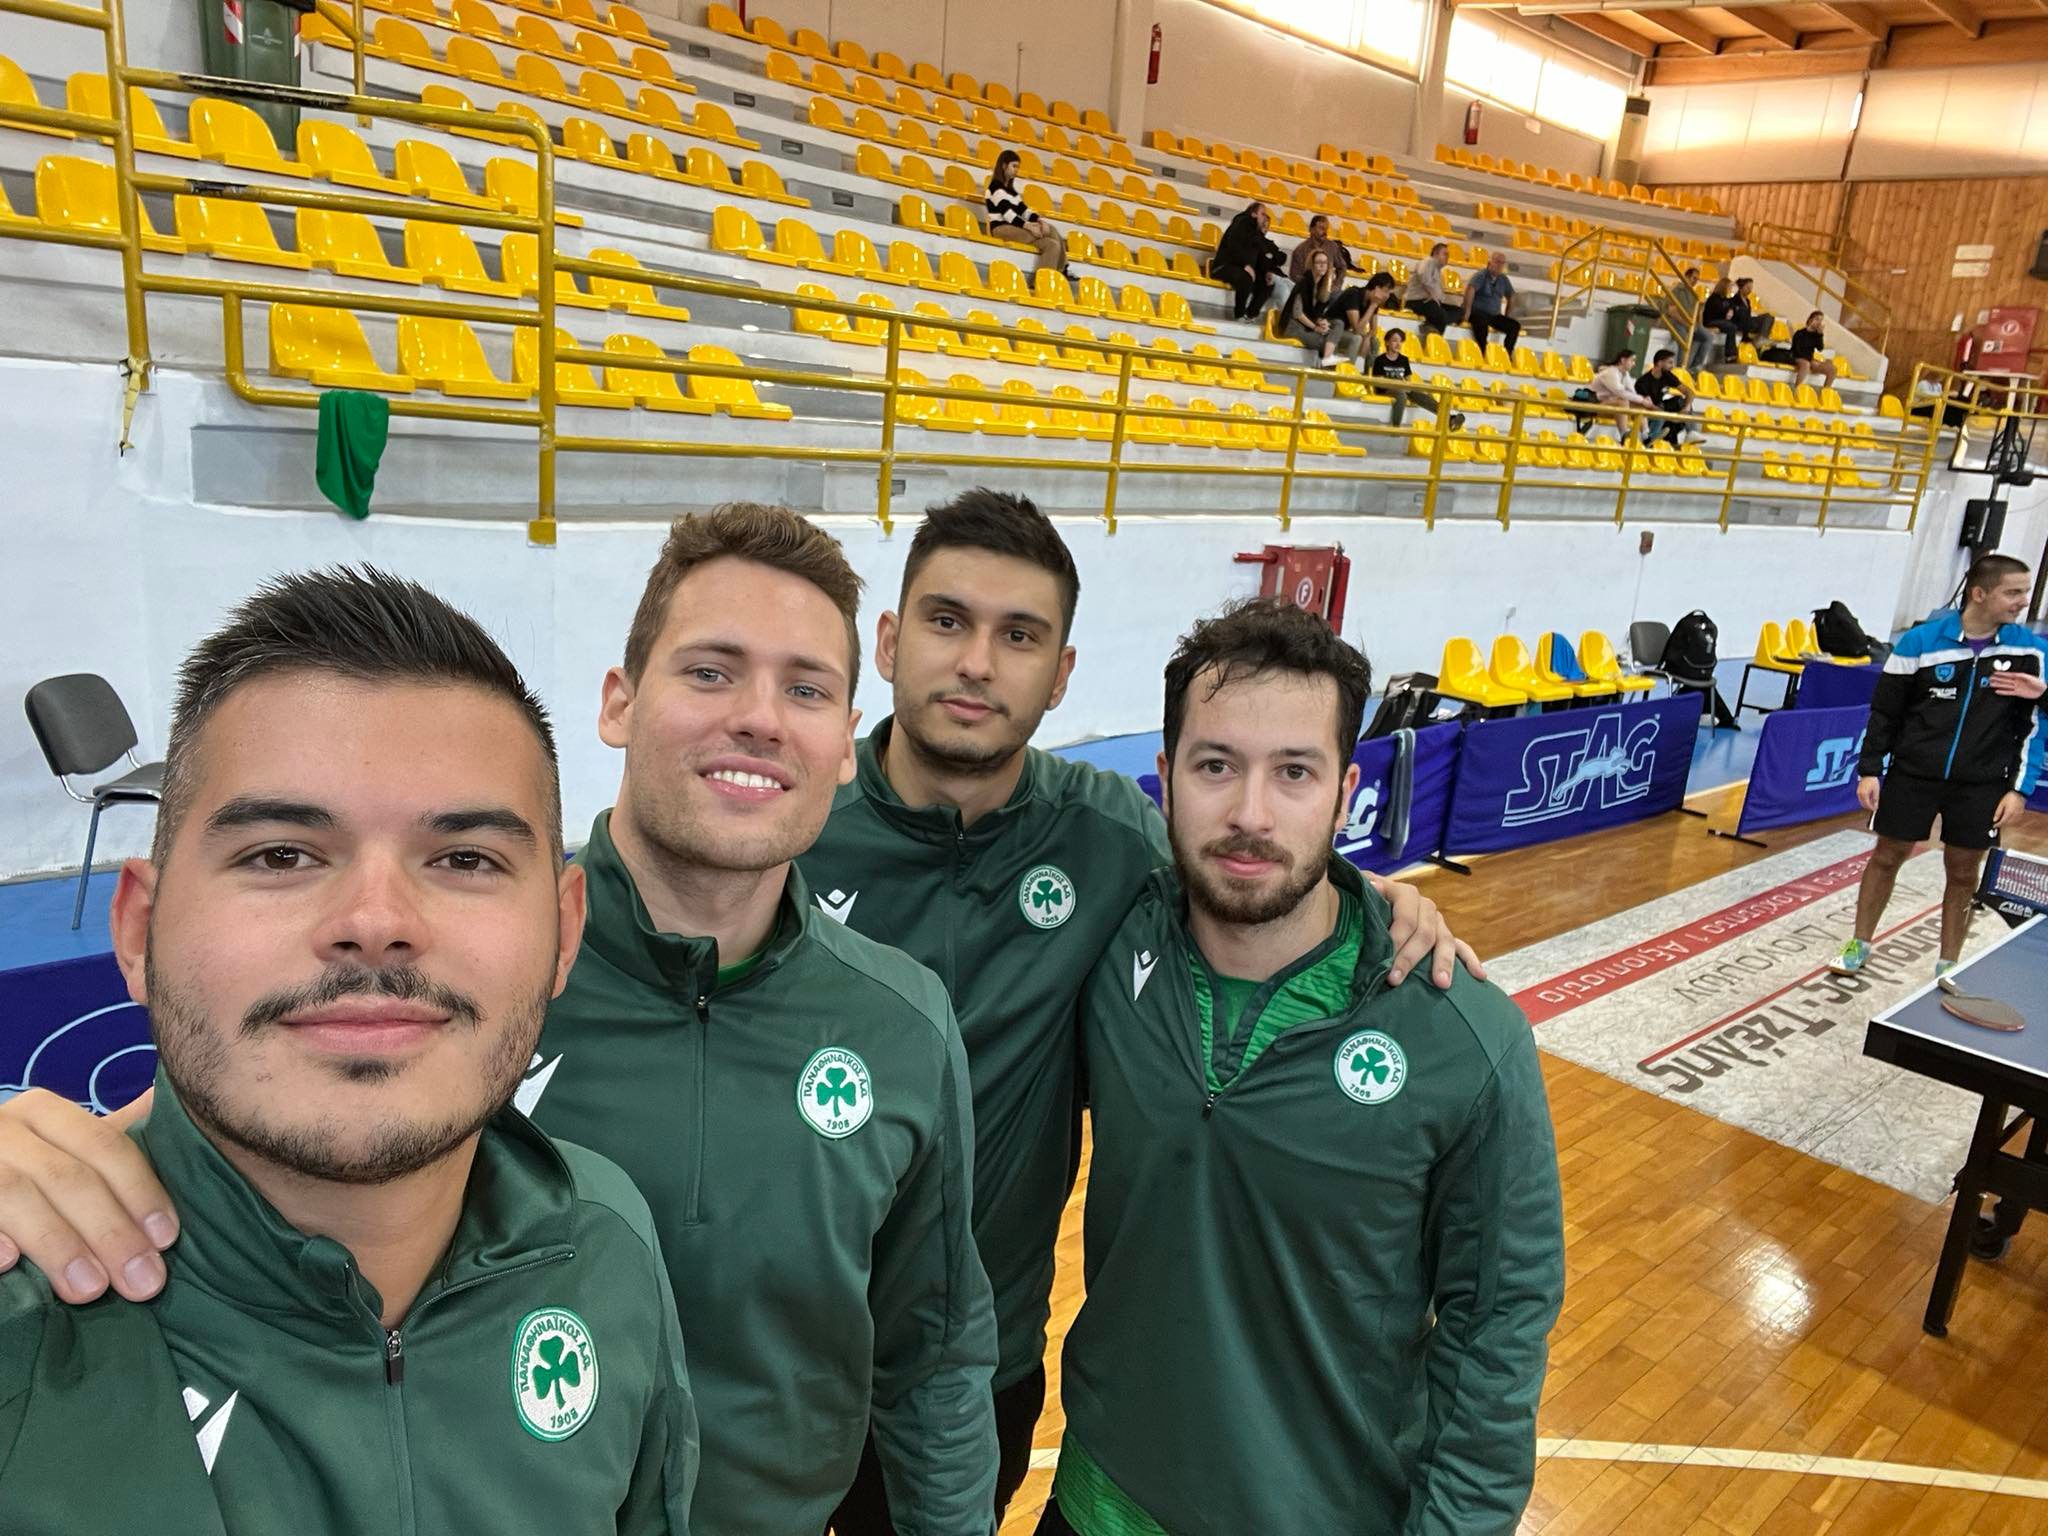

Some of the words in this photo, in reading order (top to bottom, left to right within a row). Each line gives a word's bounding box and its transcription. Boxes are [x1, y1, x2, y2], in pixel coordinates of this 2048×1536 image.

[1502, 703, 1660, 823] STAG
[826, 1119, 850, 1130] 1908
[550, 1408, 578, 1429] 1908
